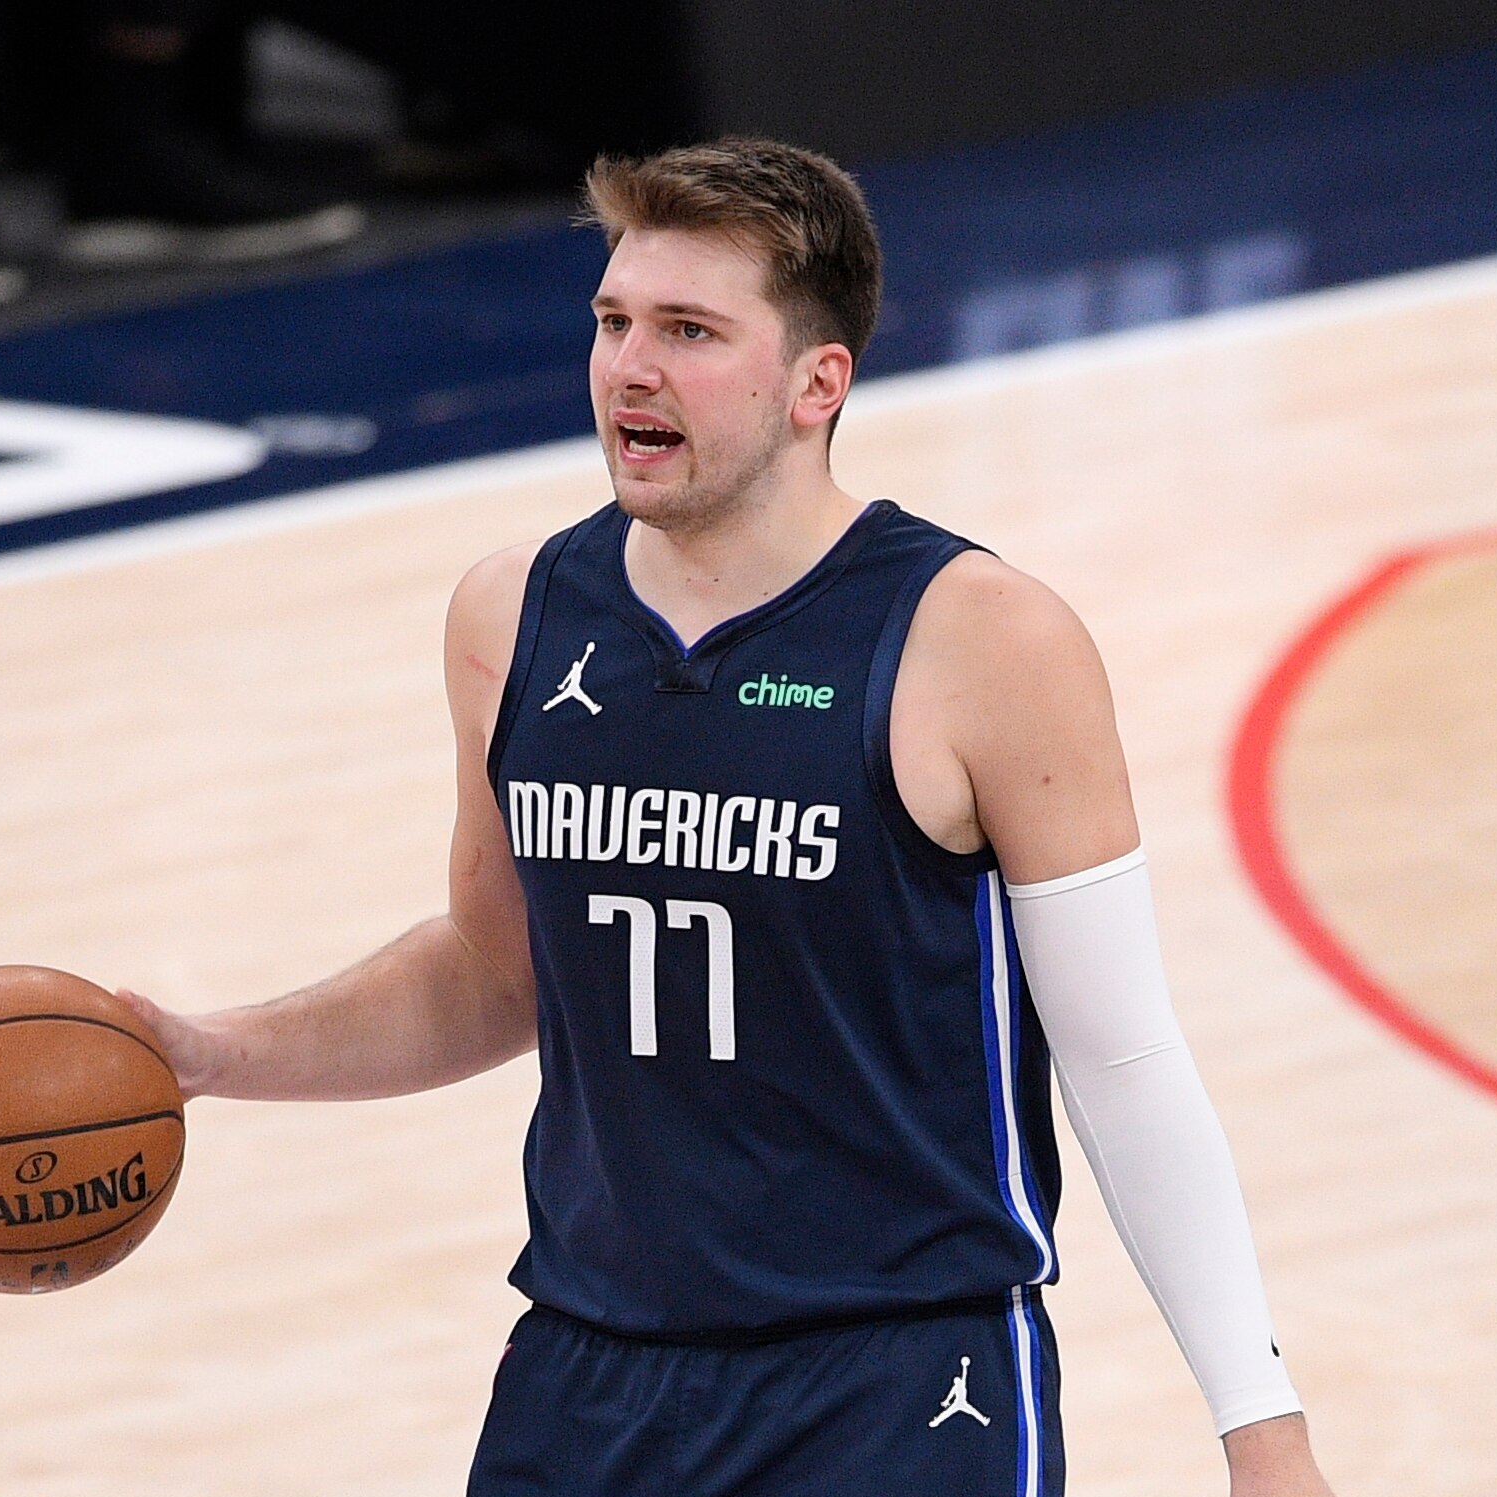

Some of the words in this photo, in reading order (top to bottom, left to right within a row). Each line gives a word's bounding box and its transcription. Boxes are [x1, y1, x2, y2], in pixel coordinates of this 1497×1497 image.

[738, 673, 835, 711] chime
[507, 779, 841, 882] MAVERICKS
[587, 893, 737, 1062] 77
